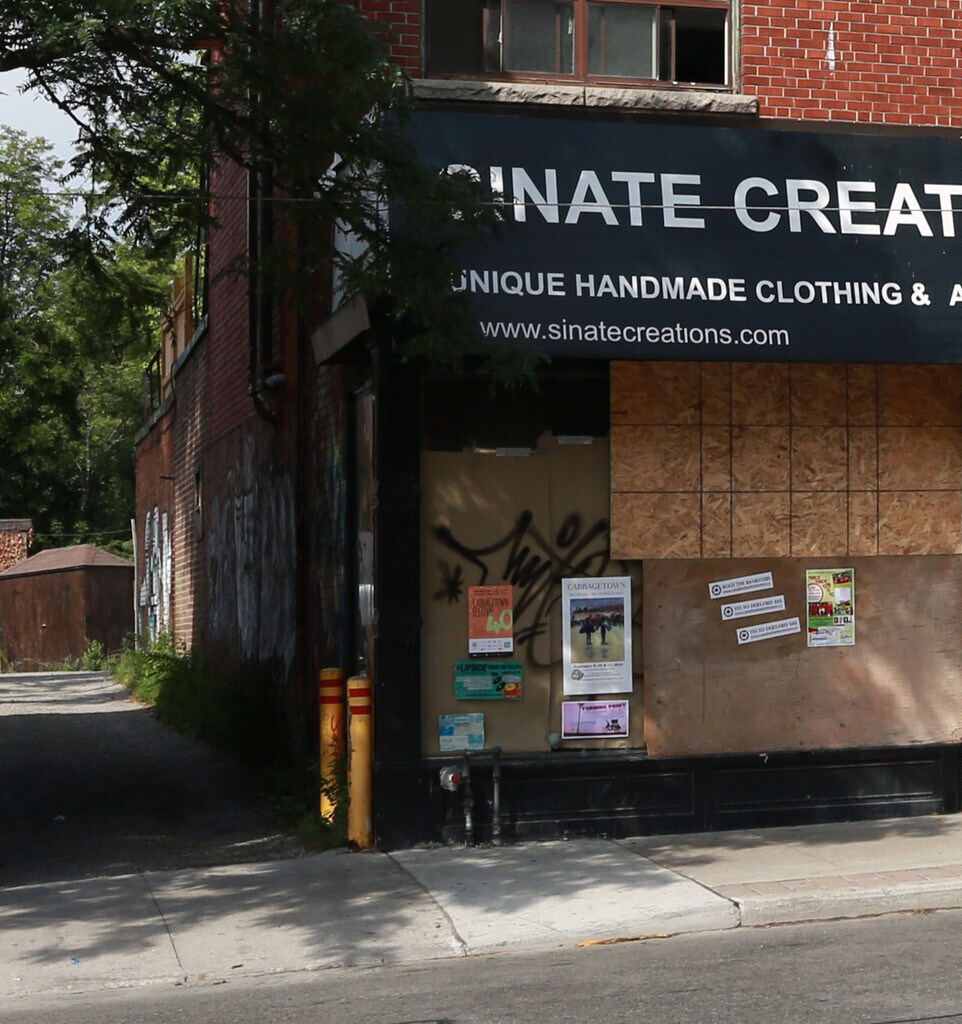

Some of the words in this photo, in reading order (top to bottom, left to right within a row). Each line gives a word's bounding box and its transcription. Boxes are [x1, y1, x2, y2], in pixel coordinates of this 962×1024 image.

[575, 273, 748, 302] HANDMADE
[755, 279, 902, 306] CLOTHING
[910, 282, 931, 307] &
[480, 319, 790, 345] www.sinatecreations.com
[567, 582, 626, 591] CABBAGETOWN
[486, 609, 513, 634] 40
